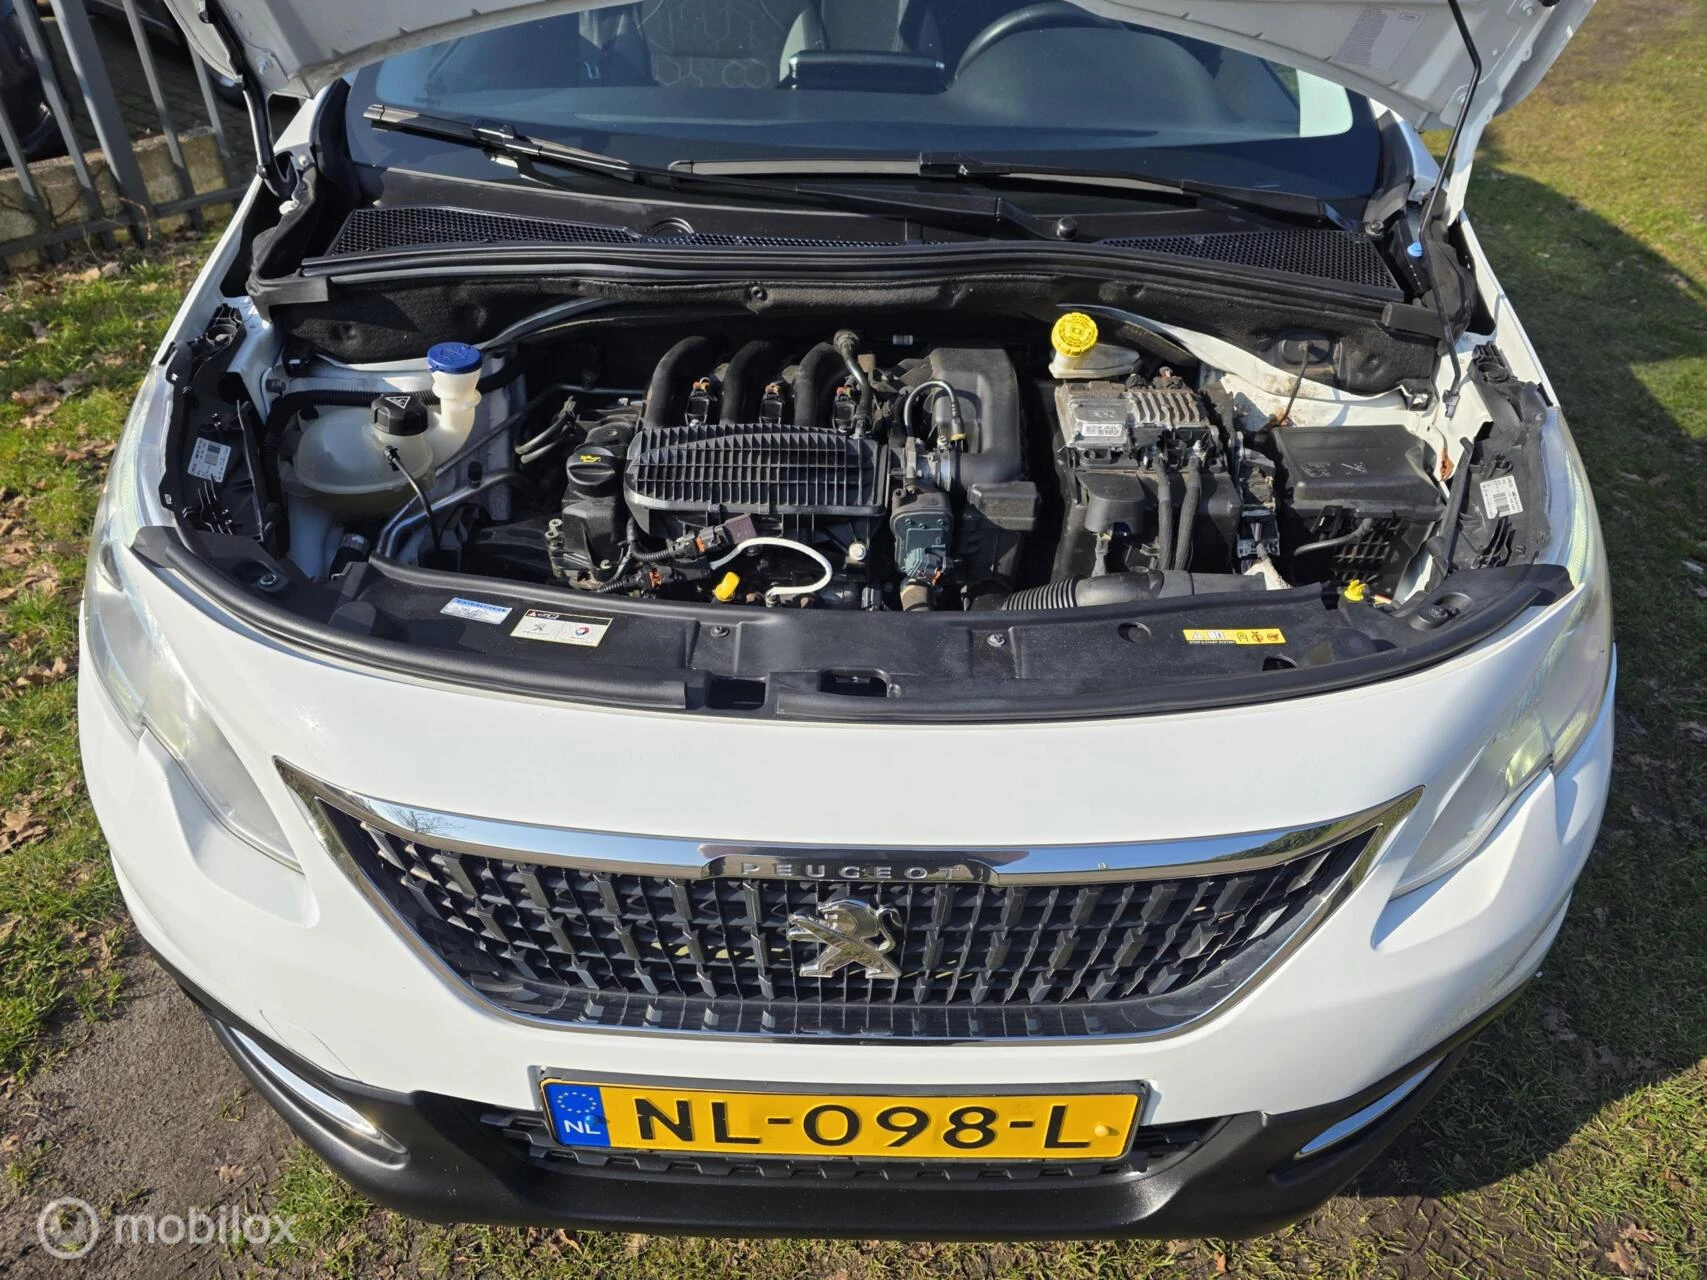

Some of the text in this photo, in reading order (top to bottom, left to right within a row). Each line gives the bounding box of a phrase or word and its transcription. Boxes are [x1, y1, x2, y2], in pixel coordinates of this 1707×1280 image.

[740, 862, 959, 879] PEUGEOT
[563, 1097, 1091, 1150] NL NL-098-L
